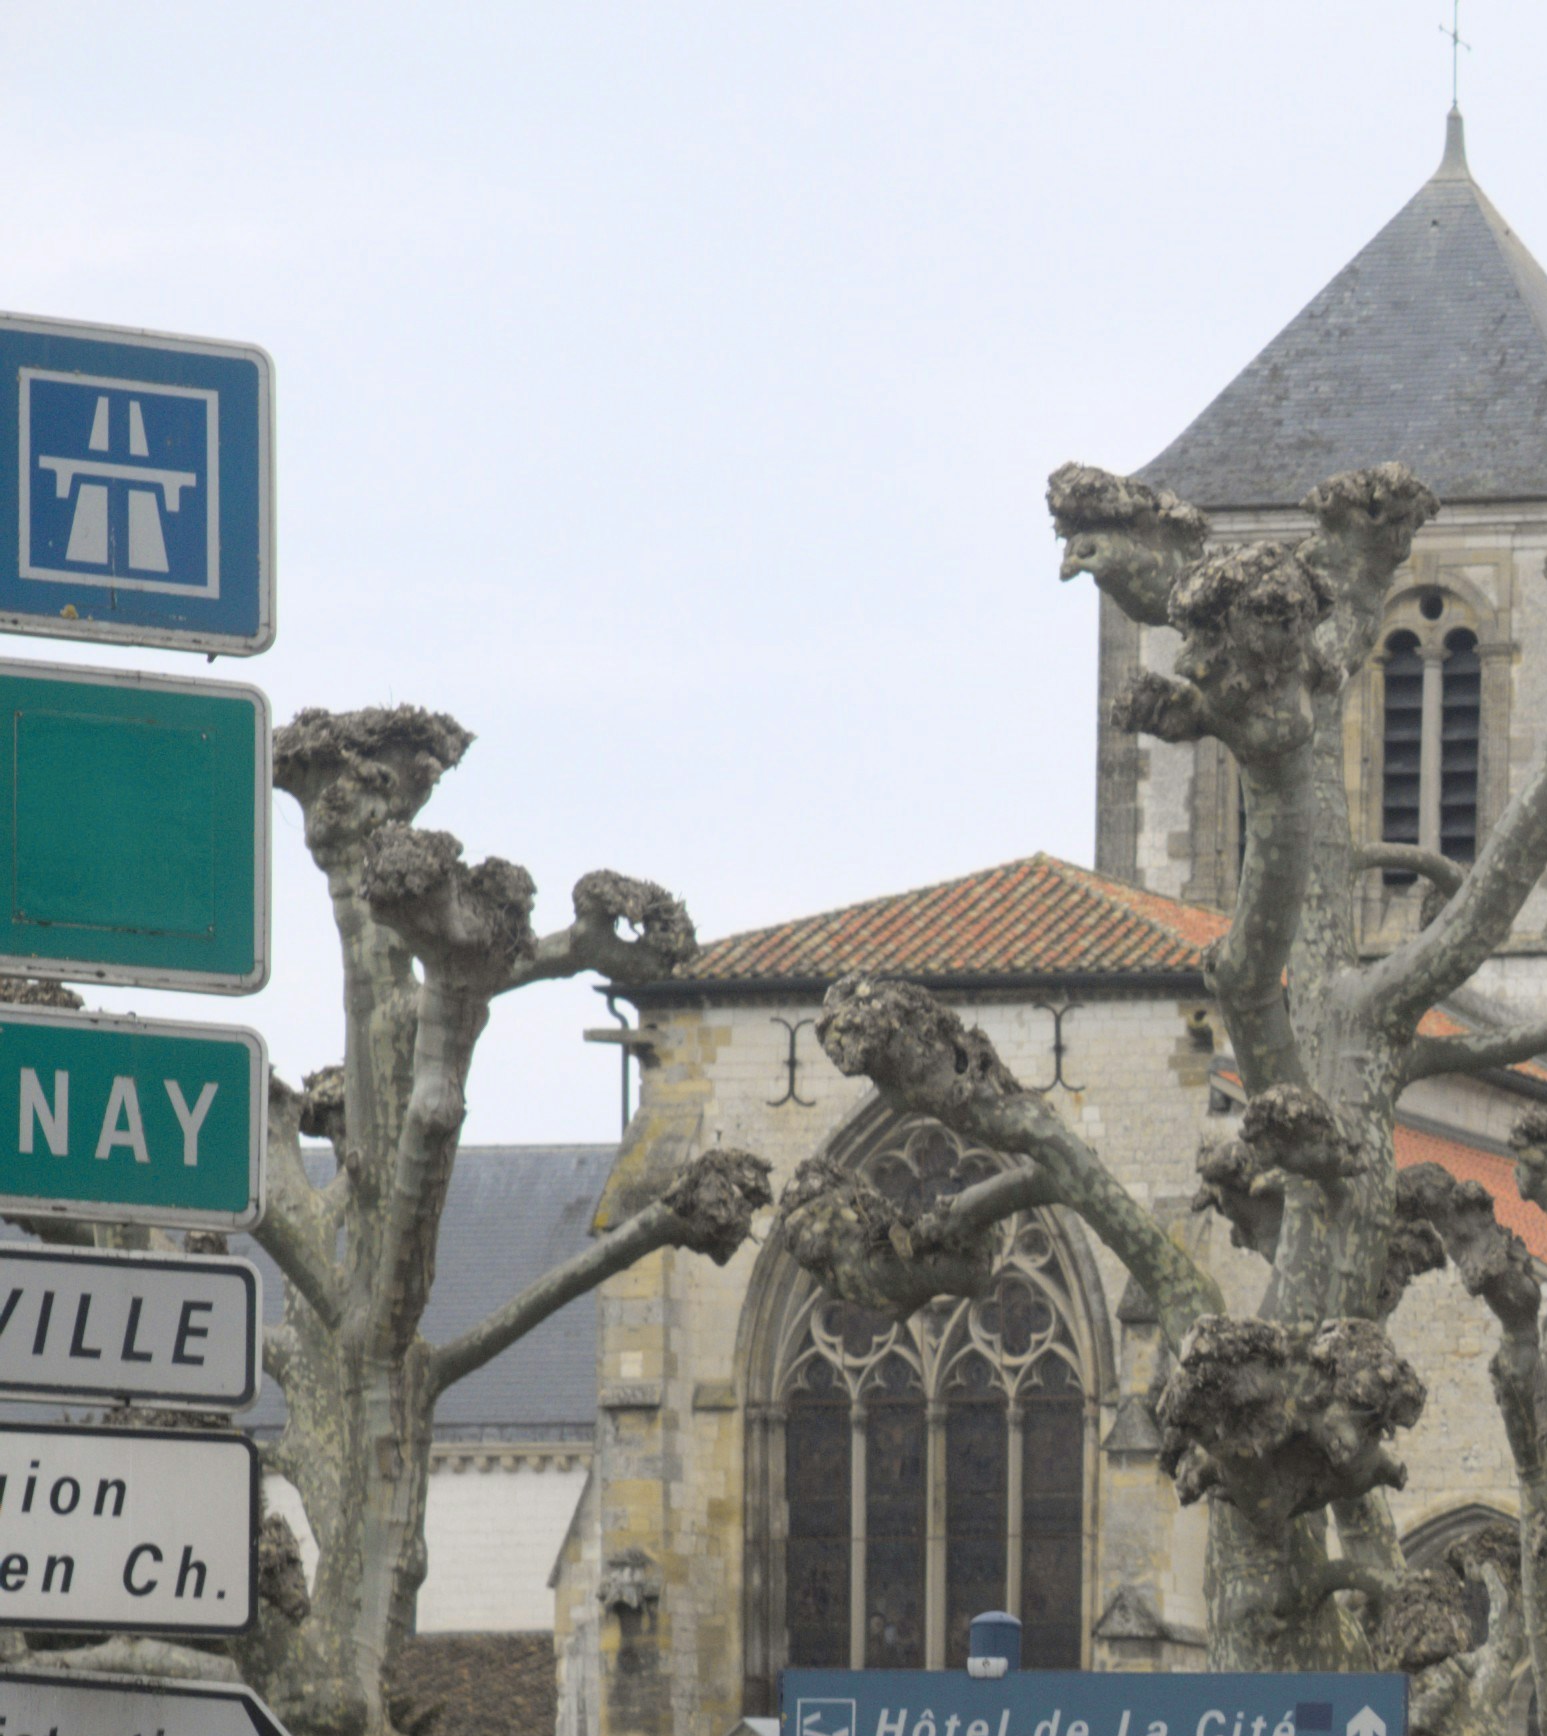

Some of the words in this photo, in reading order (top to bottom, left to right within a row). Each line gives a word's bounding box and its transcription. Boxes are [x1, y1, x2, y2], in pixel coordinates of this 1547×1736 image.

[19, 1067, 219, 1167] NAY
[0, 1460, 127, 1517] ion
[122, 1542, 227, 1600] Ch.
